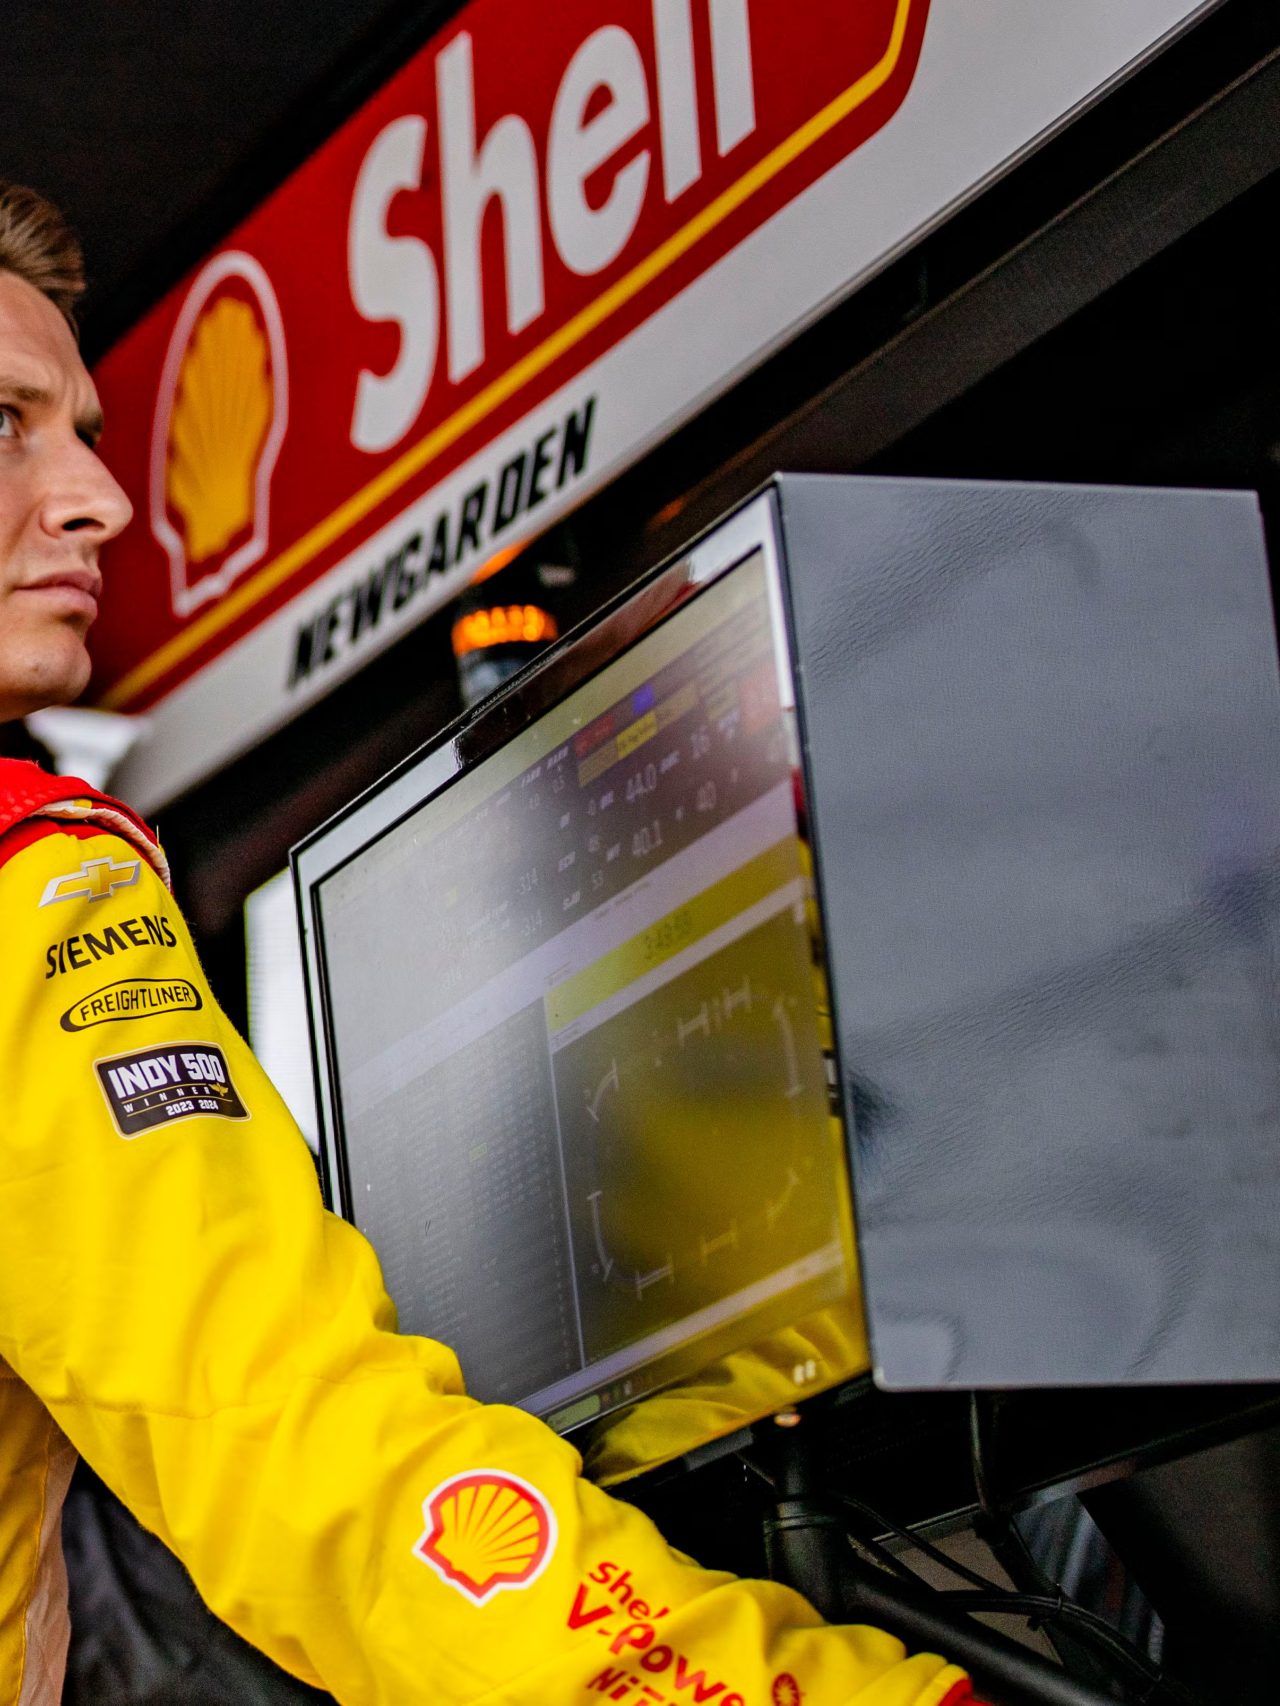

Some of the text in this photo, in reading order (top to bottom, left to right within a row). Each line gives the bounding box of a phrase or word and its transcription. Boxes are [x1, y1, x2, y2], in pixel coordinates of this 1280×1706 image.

[287, 396, 597, 688] NEWGARDEN
[45, 915, 177, 979] SIEMENS
[80, 986, 193, 1021] FREIGHTLINER
[108, 1053, 226, 1099] INDY 500
[124, 1086, 211, 1113] WINNER
[166, 1099, 219, 1116] 2023 2024
